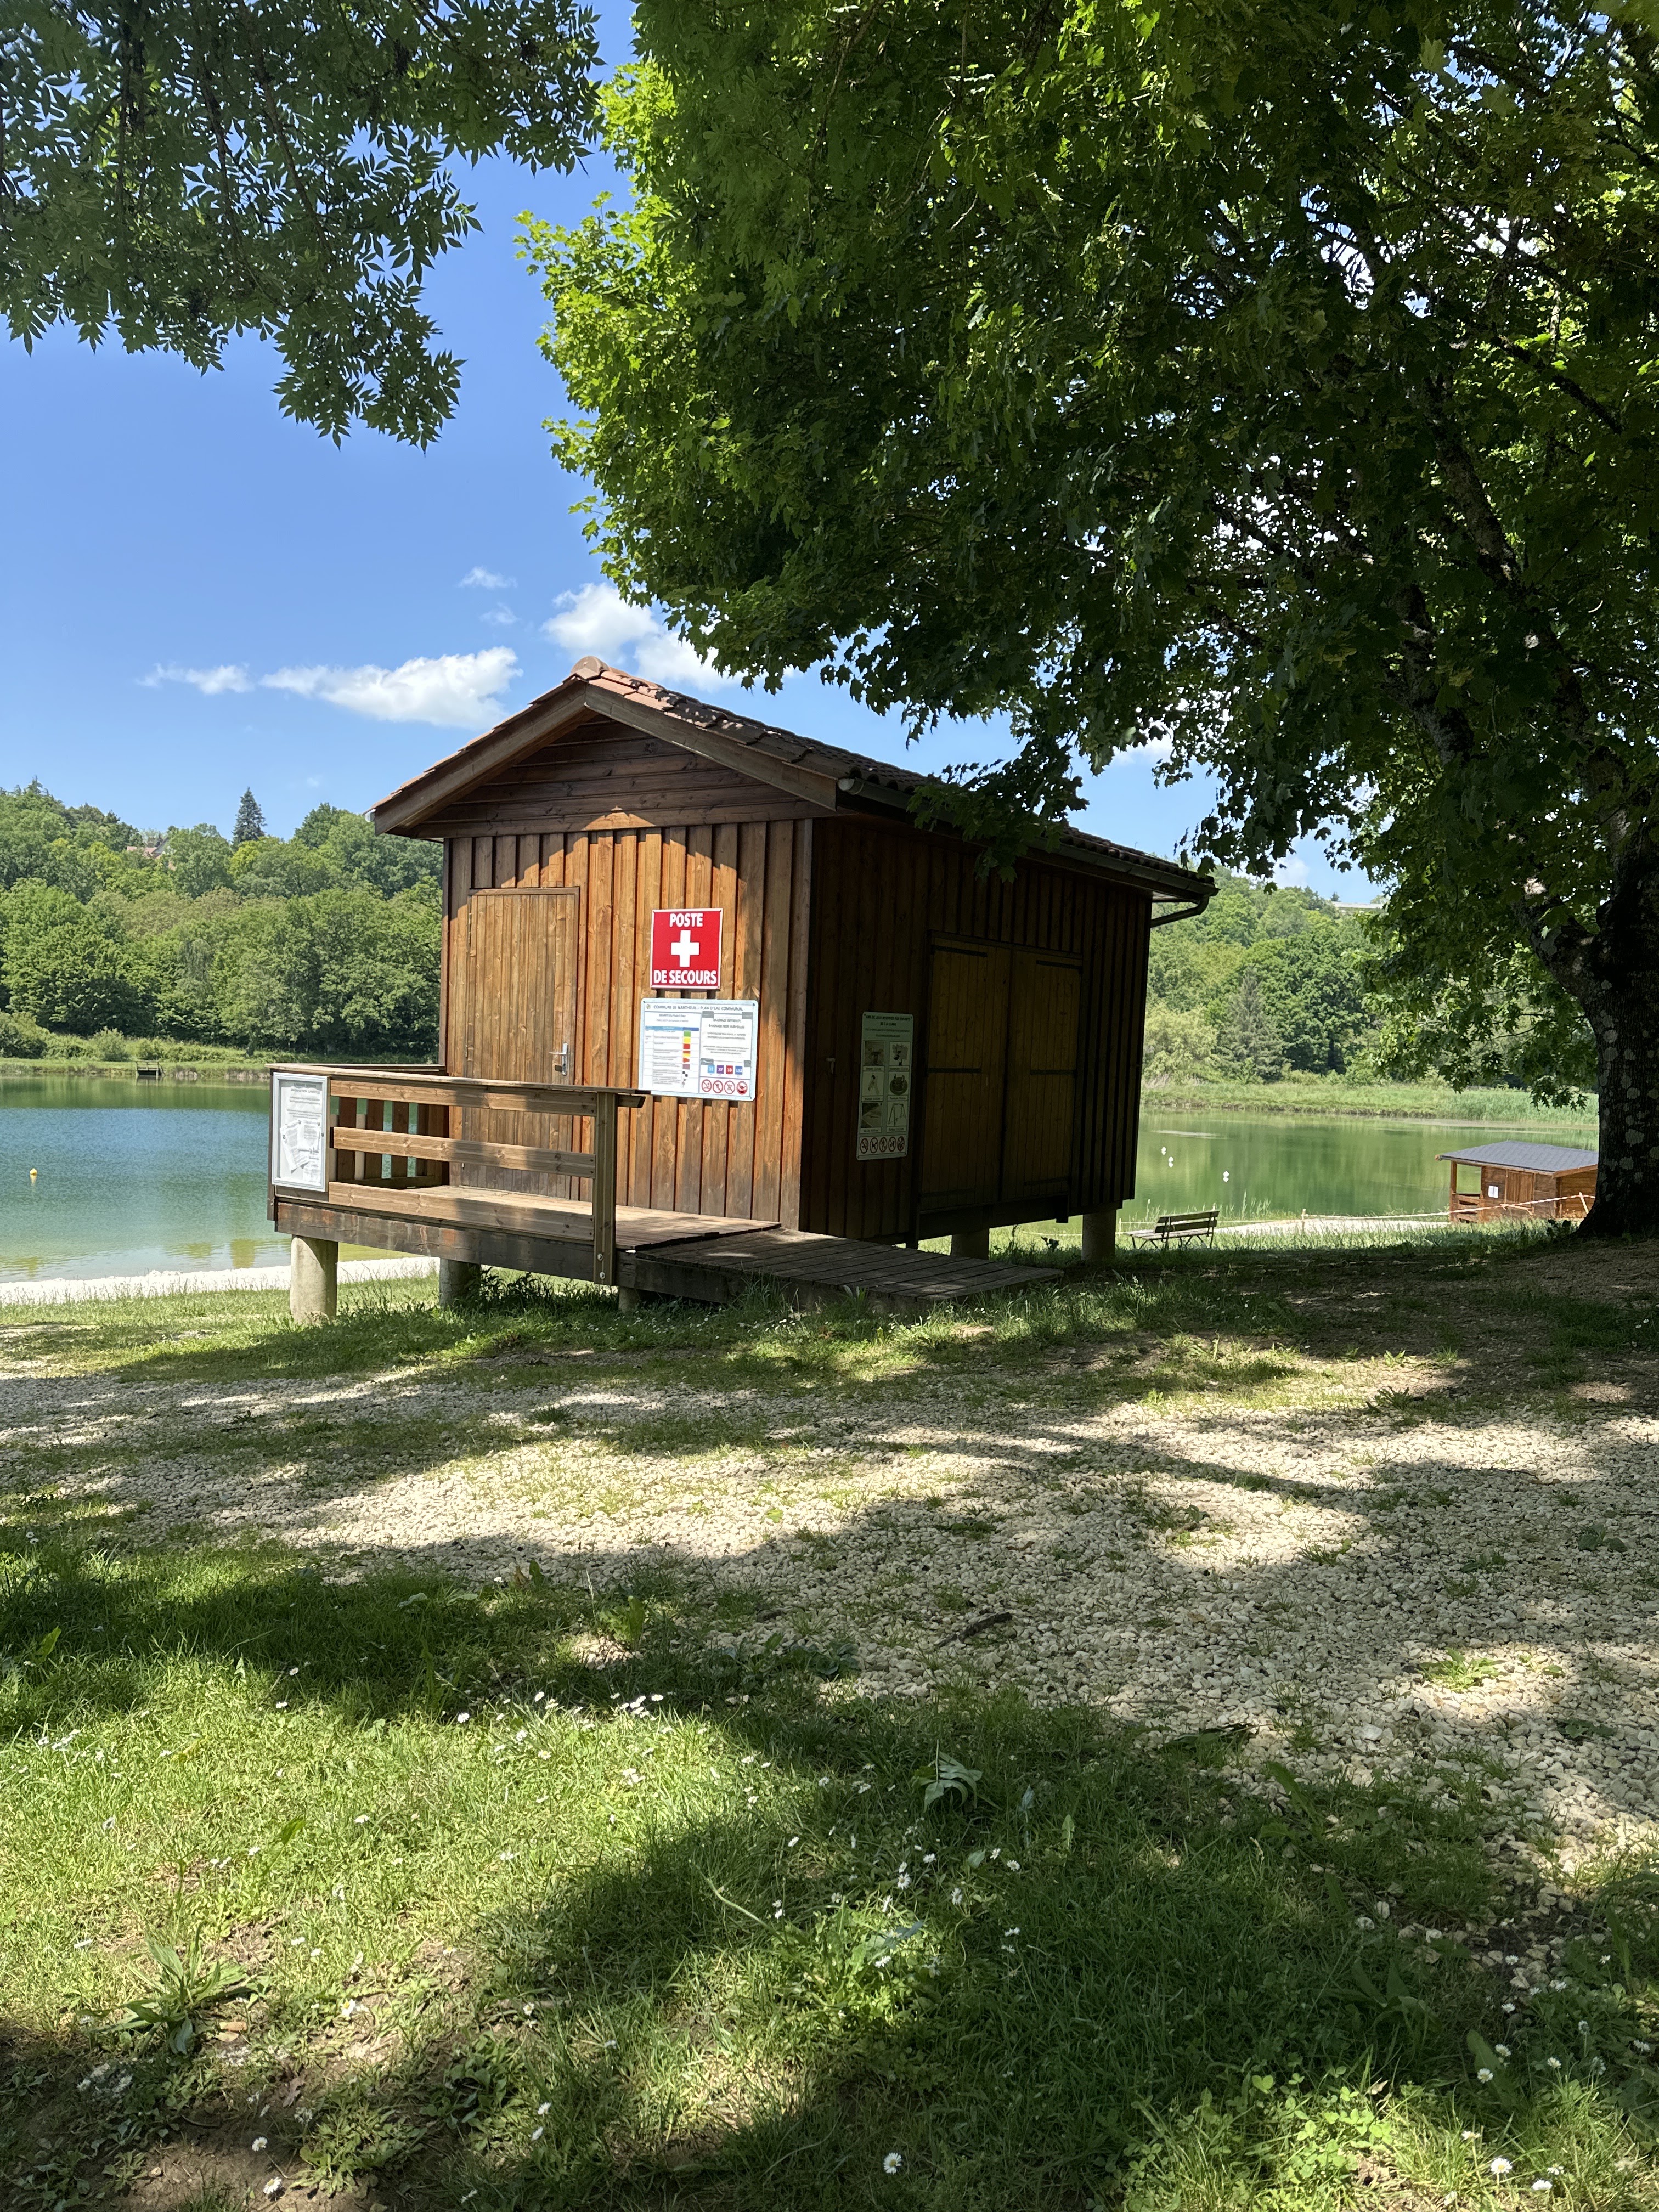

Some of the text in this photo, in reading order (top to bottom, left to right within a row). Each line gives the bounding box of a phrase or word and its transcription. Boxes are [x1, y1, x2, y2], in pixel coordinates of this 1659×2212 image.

[669, 913, 703, 927] POSTE
[653, 970, 717, 984] DE SECOURS
